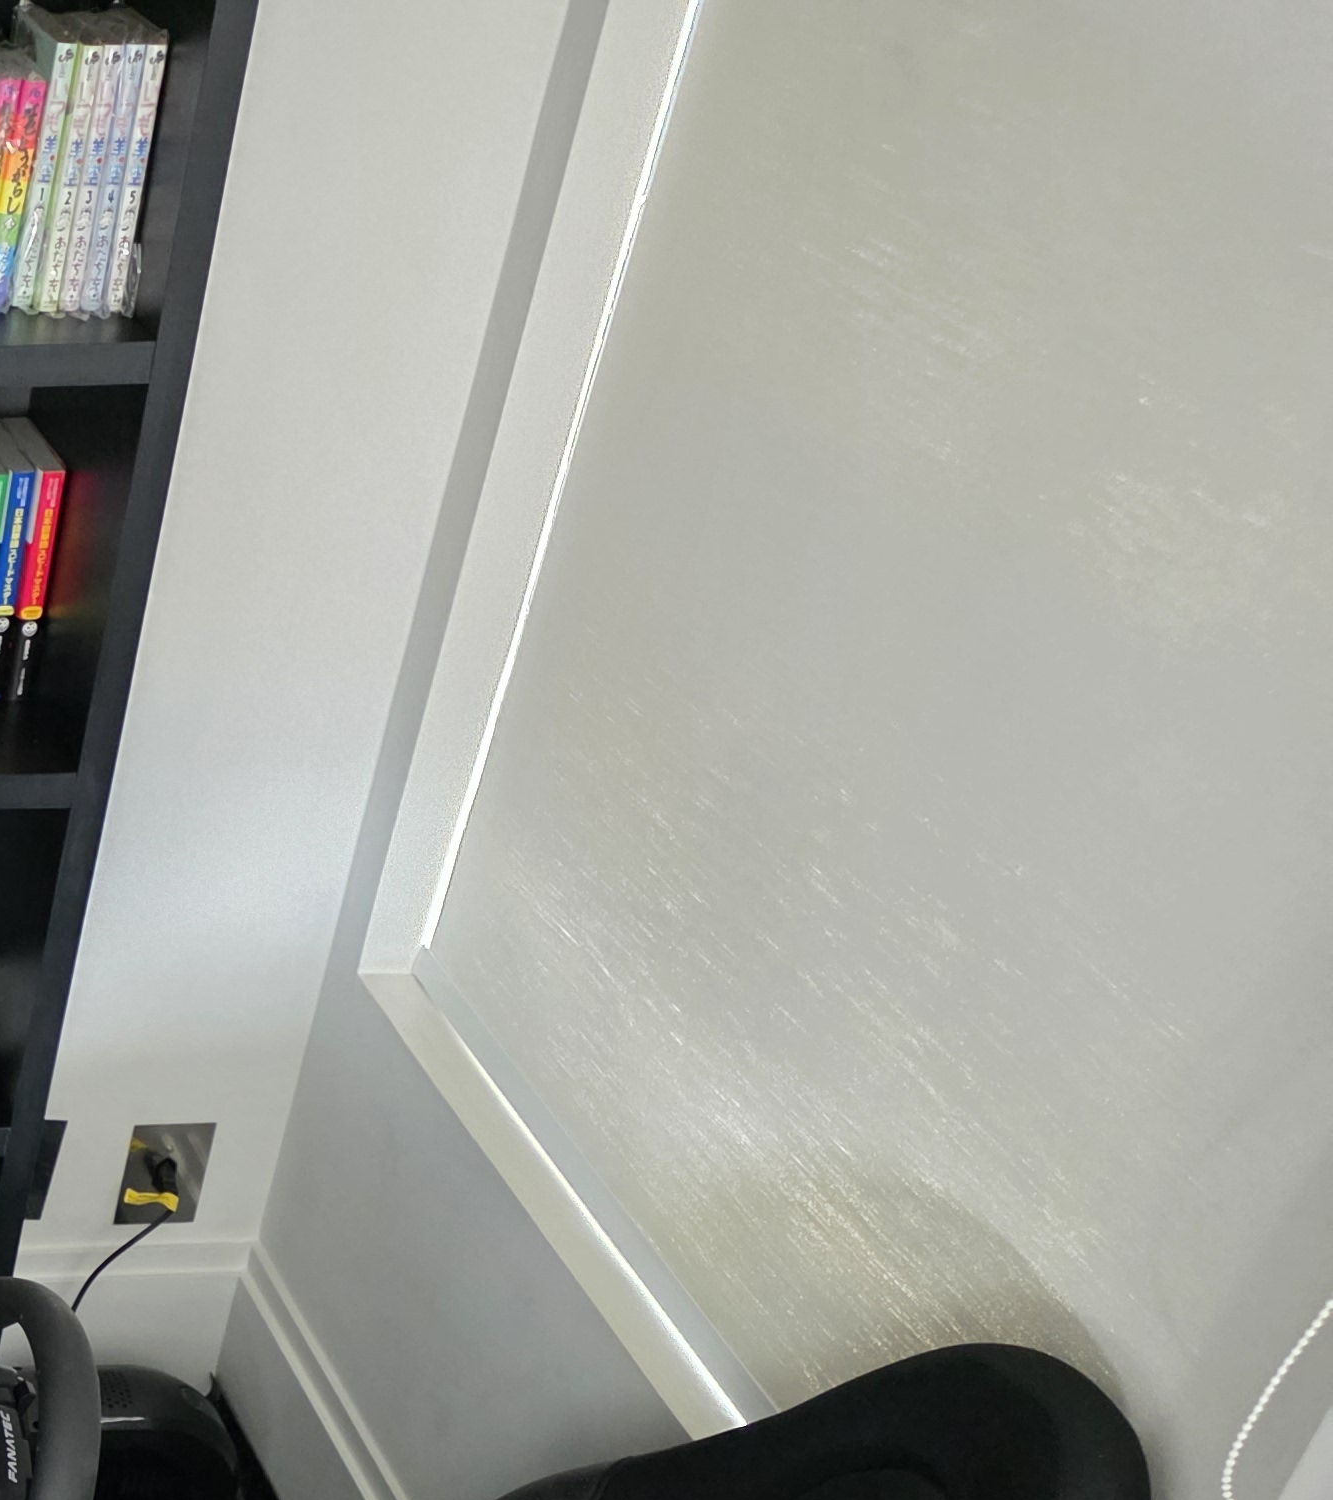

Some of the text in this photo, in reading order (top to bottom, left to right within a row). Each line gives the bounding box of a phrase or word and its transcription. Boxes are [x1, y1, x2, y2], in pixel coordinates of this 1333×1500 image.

[64, 192, 72, 205] 2
[86, 191, 92, 204] 3
[130, 191, 136, 204] 5
[0, 1410, 18, 1484] FANATEC
